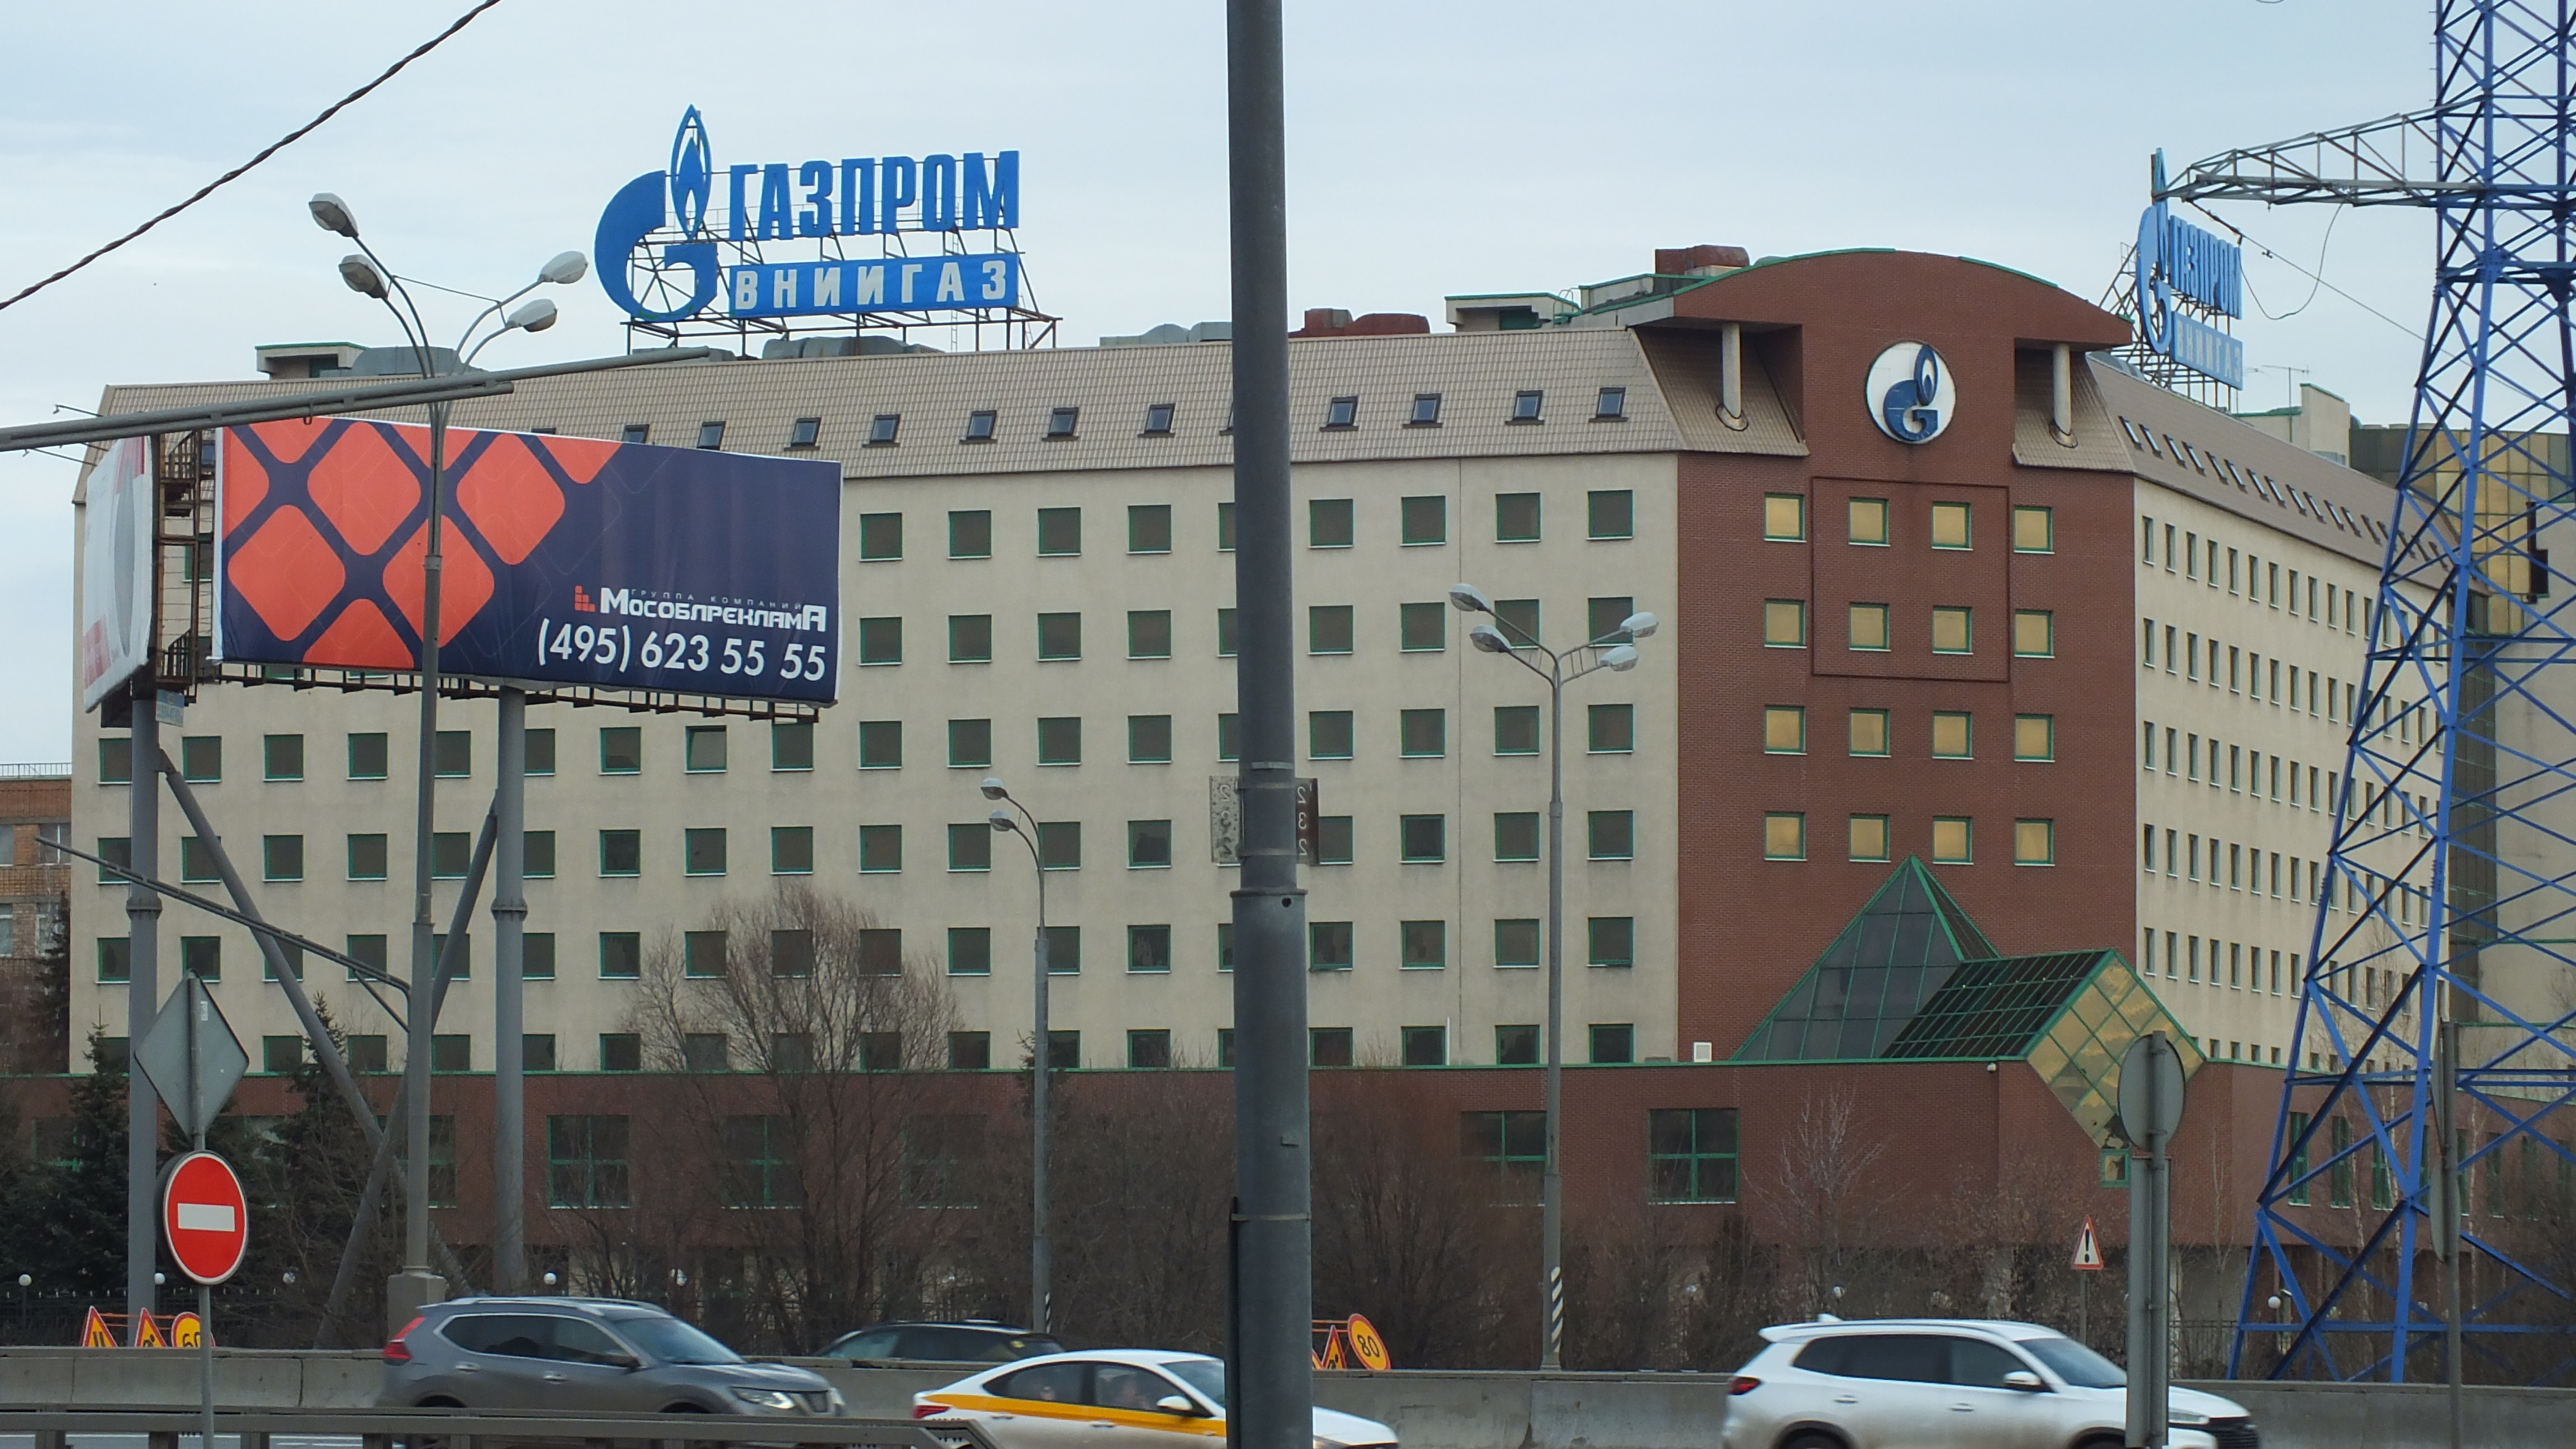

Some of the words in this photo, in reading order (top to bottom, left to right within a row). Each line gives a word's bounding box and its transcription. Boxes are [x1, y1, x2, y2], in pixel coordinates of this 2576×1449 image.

[730, 150, 1020, 242] ГАЗПРОМ
[735, 259, 1007, 311] ВНИИГАЗ
[631, 589, 694, 600] ГРУППА
[711, 596, 802, 609] КОМПАНИЙ
[538, 618, 631, 673] (495)
[641, 631, 710, 672] 623
[721, 638, 765, 676] 55
[780, 643, 826, 681] 55
[1357, 1334, 1380, 1358] 80
